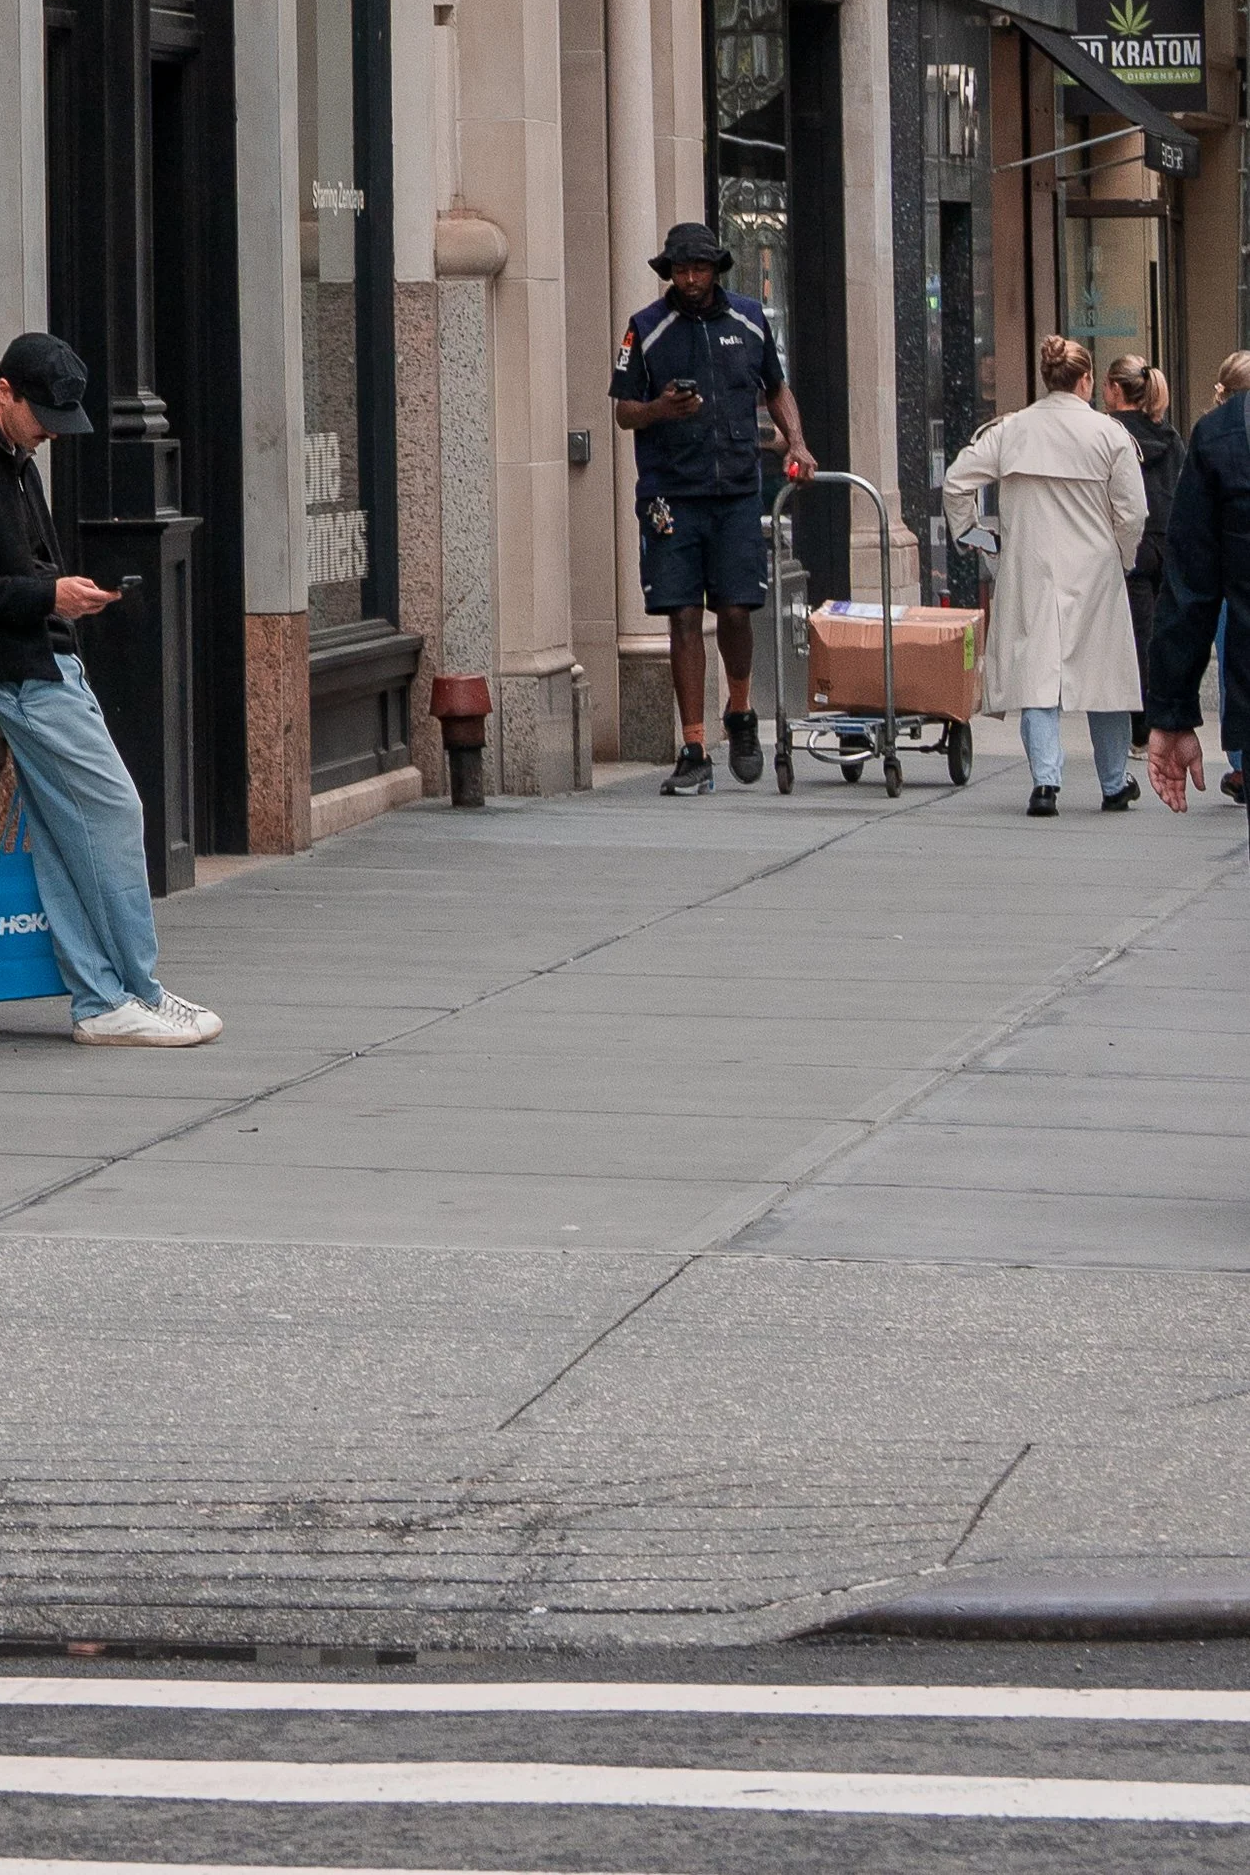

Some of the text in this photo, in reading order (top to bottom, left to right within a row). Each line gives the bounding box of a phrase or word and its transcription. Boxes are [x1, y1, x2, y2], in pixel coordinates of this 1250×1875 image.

[1111, 40, 1201, 67] KRATOM
[1127, 70, 1197, 81] DISPENSARY
[0, 911, 49, 936] HOK
